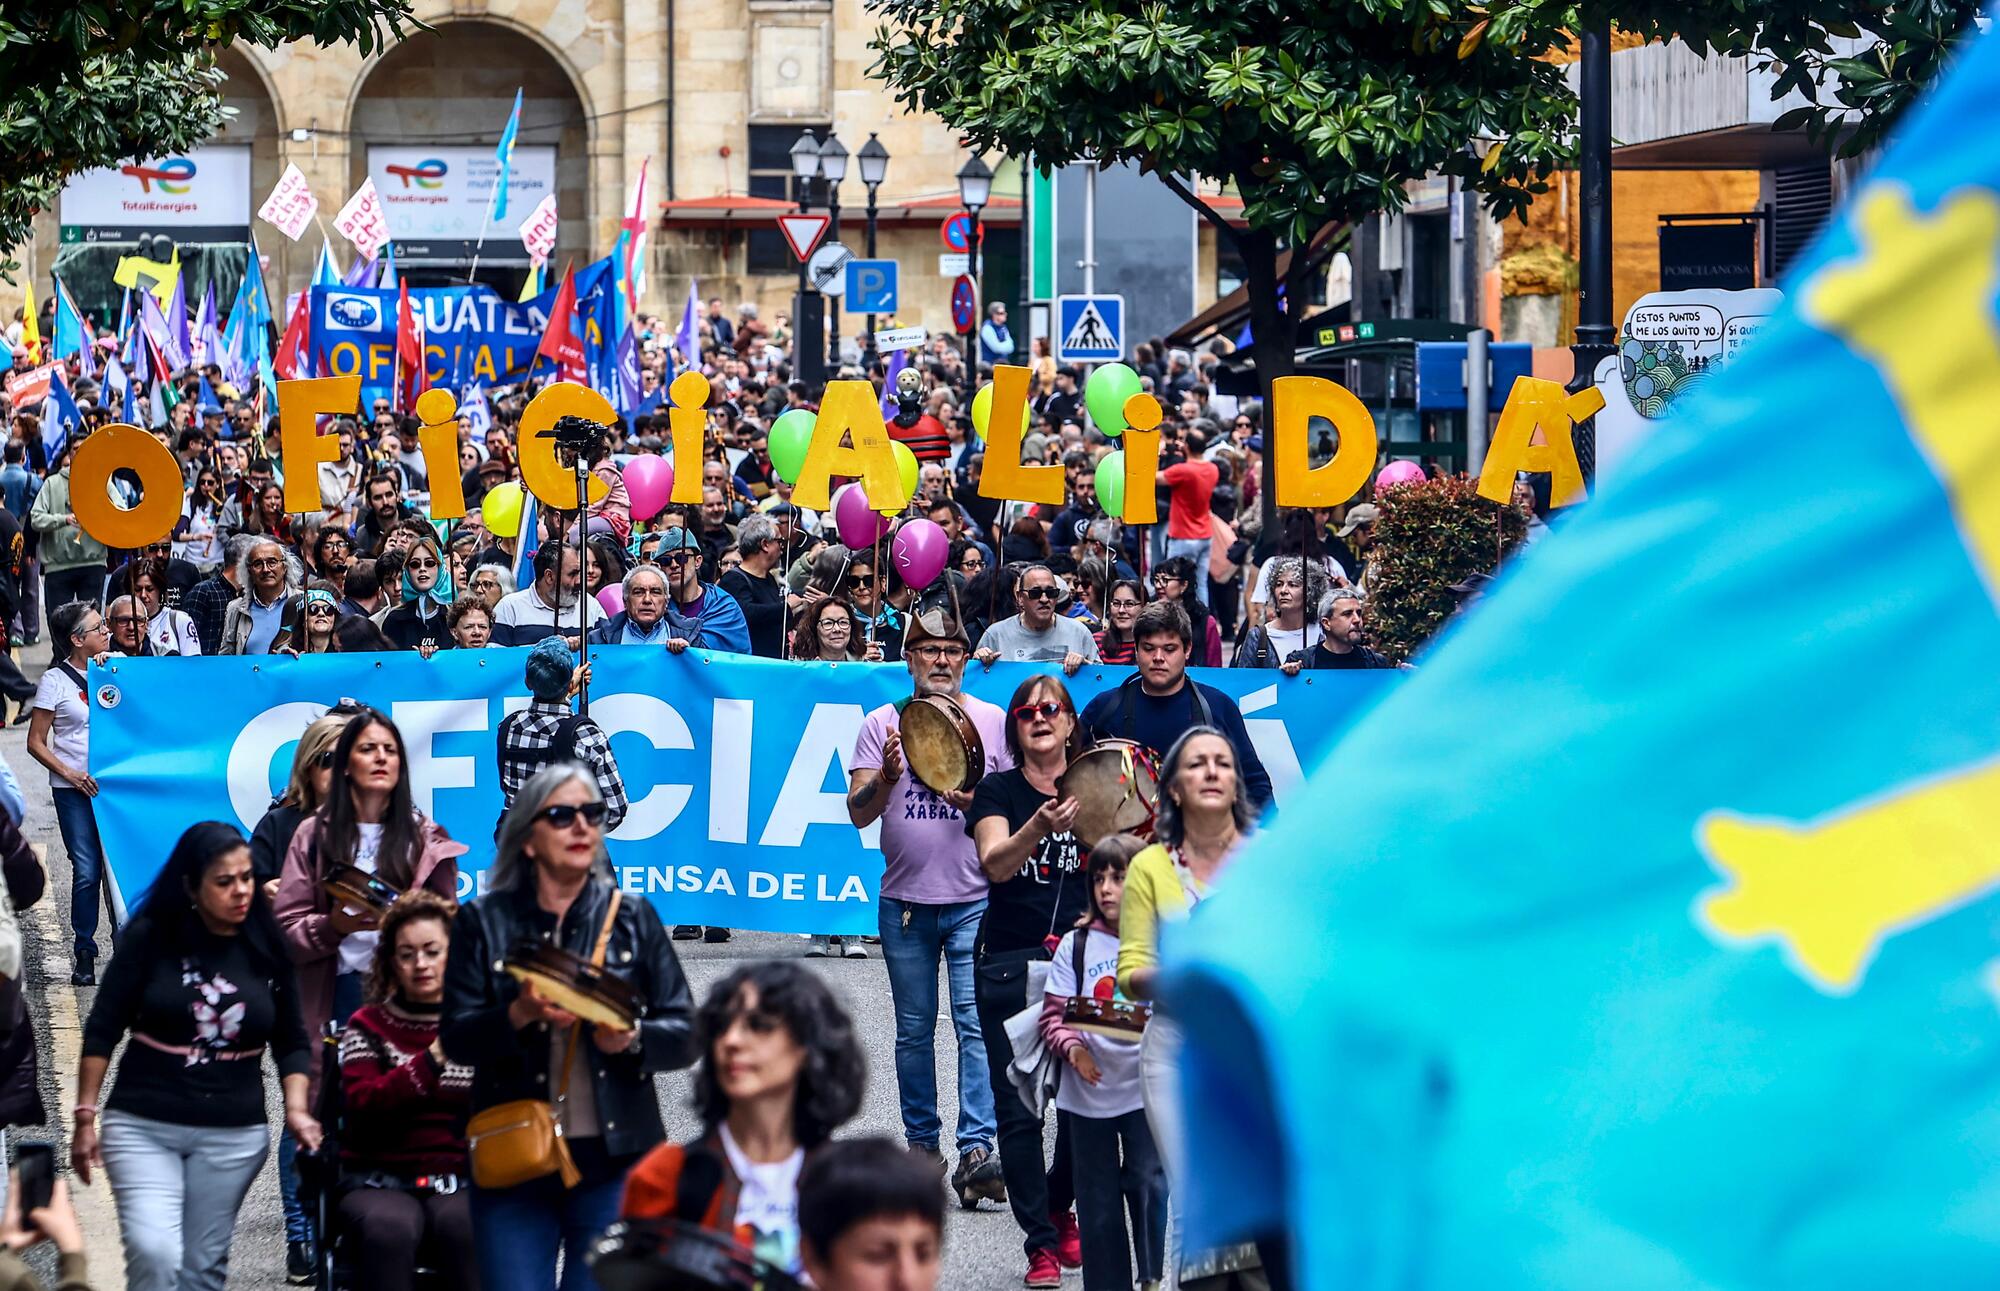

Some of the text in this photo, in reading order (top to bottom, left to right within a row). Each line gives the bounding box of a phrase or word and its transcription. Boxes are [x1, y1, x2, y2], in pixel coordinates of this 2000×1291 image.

[386, 195, 449, 205] TotalEnergies
[122, 201, 198, 212] TotalEnergies
[1664, 262, 1752, 276] PORCELANOSA
[857, 268, 885, 305] P
[1636, 311, 1701, 323] ESTOS PUNTOS
[1636, 326, 1649, 336] ME
[1652, 326, 1669, 336] LOS
[1728, 339, 1739, 348] TE
[747, 871, 806, 900] DE
[816, 874, 870, 903] LA
